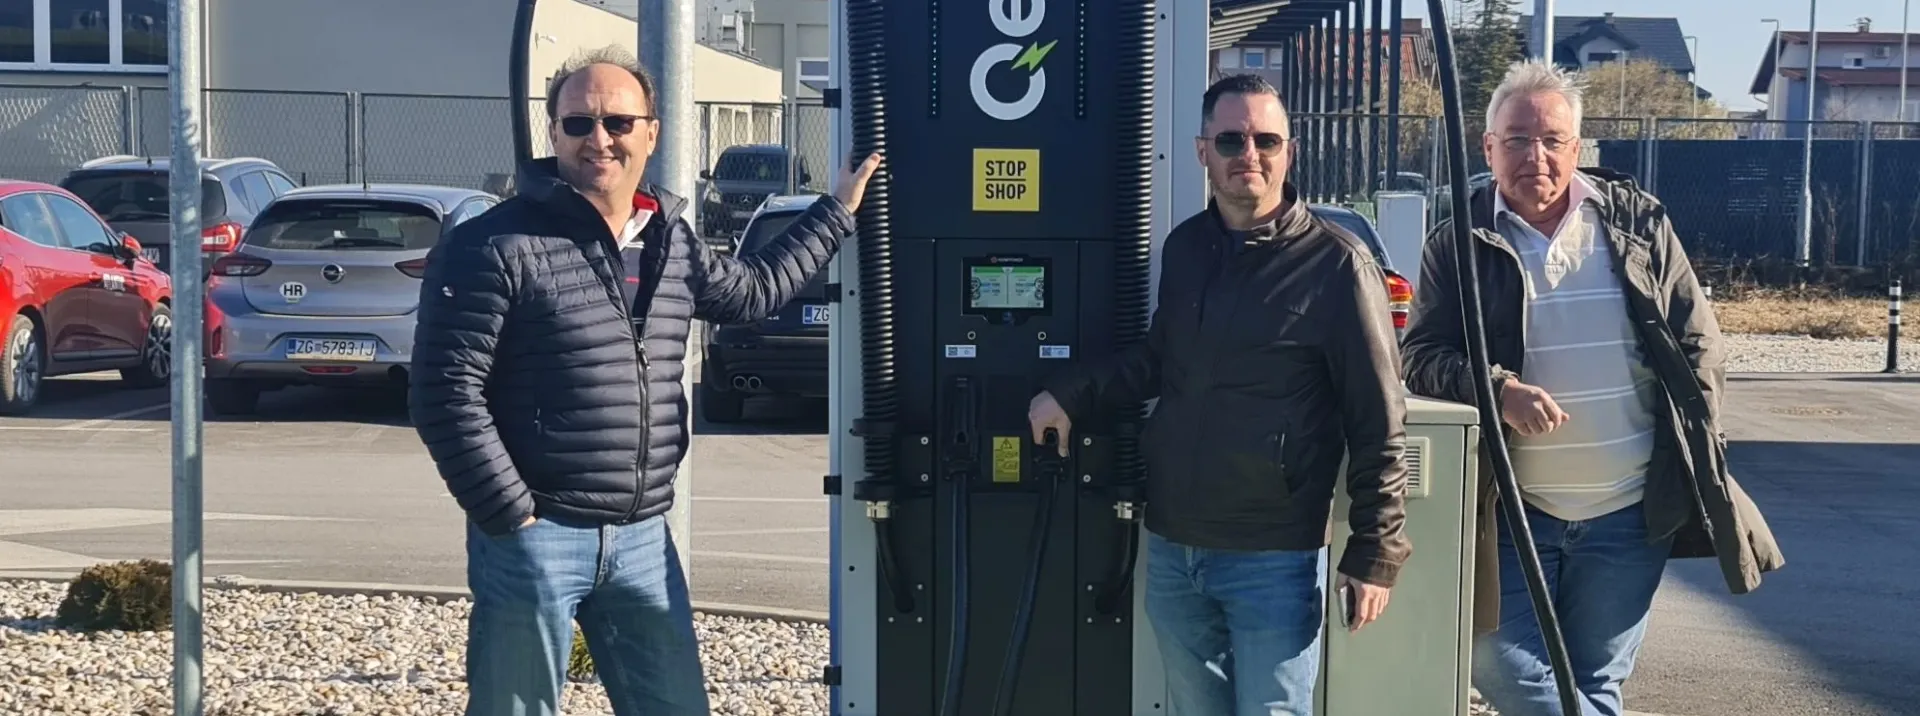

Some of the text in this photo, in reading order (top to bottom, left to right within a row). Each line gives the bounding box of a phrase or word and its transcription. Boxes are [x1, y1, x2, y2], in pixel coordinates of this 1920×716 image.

[985, 160, 1027, 176] STOP
[985, 183, 1027, 200] SHOP
[283, 284, 303, 296] HR
